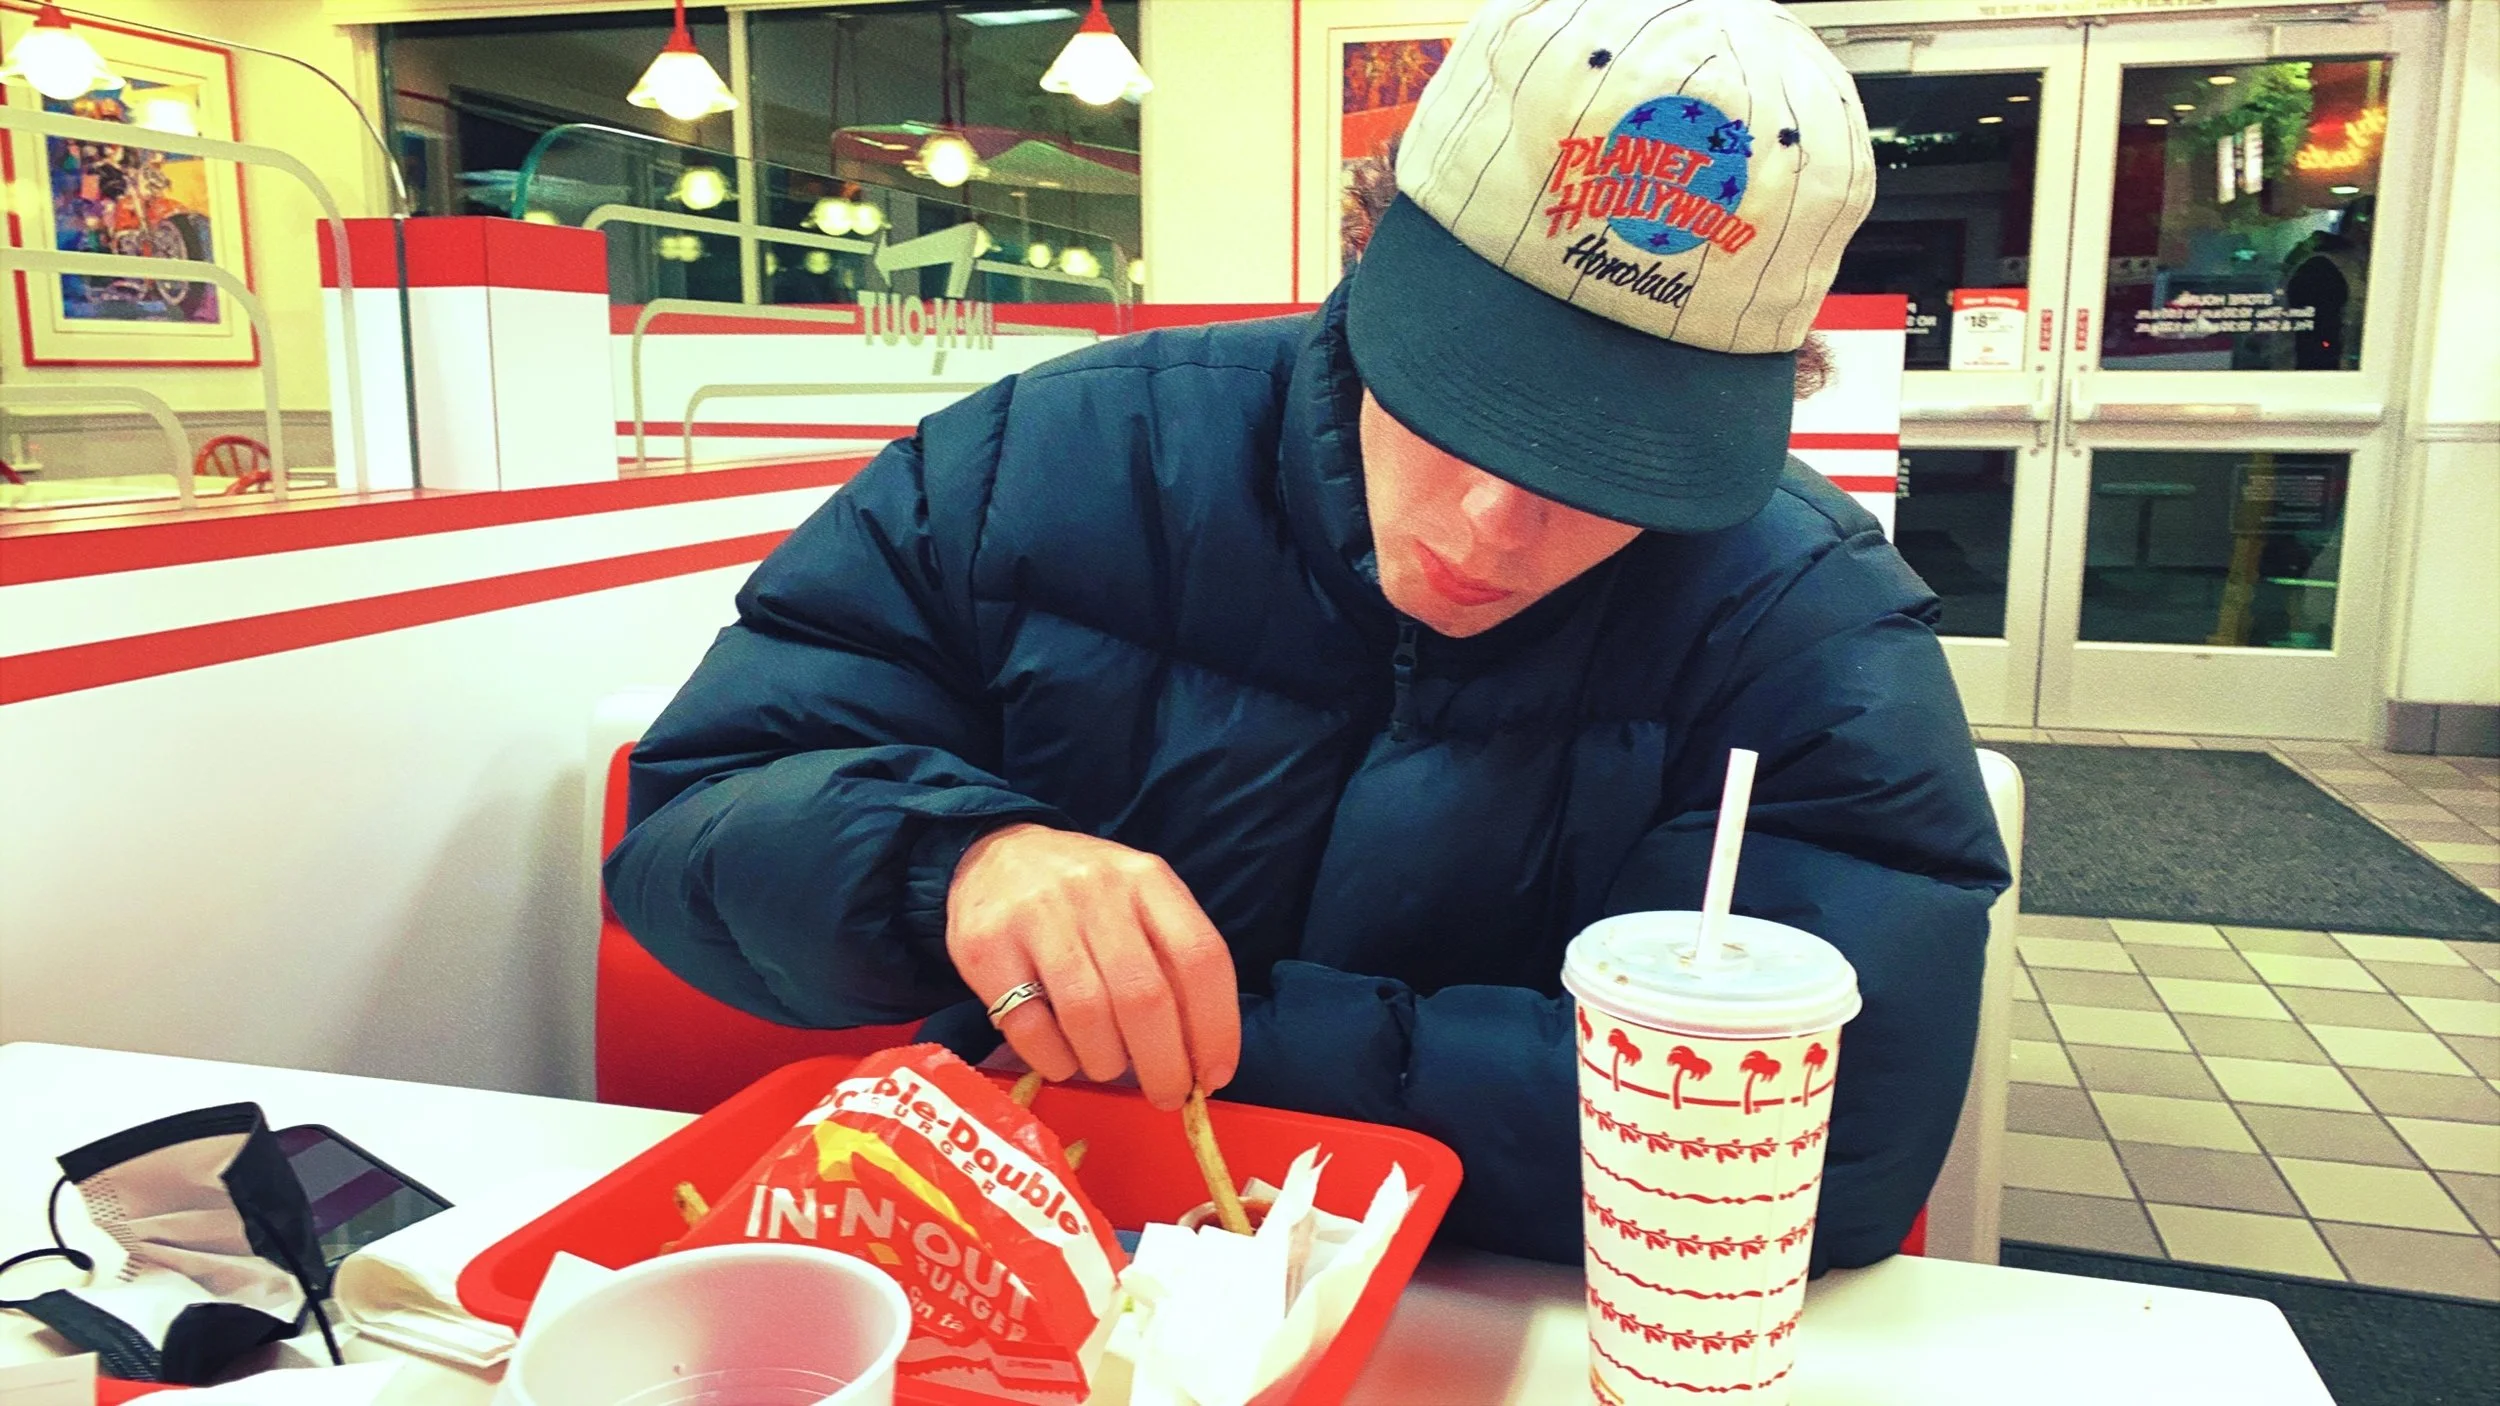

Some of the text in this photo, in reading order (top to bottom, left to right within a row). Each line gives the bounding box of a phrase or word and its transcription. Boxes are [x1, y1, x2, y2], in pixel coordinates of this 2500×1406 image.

[1550, 134, 1711, 193] PLANET
[1545, 177, 1757, 254] HOLLYWOOD
[1562, 233, 1694, 308] Honolulu
